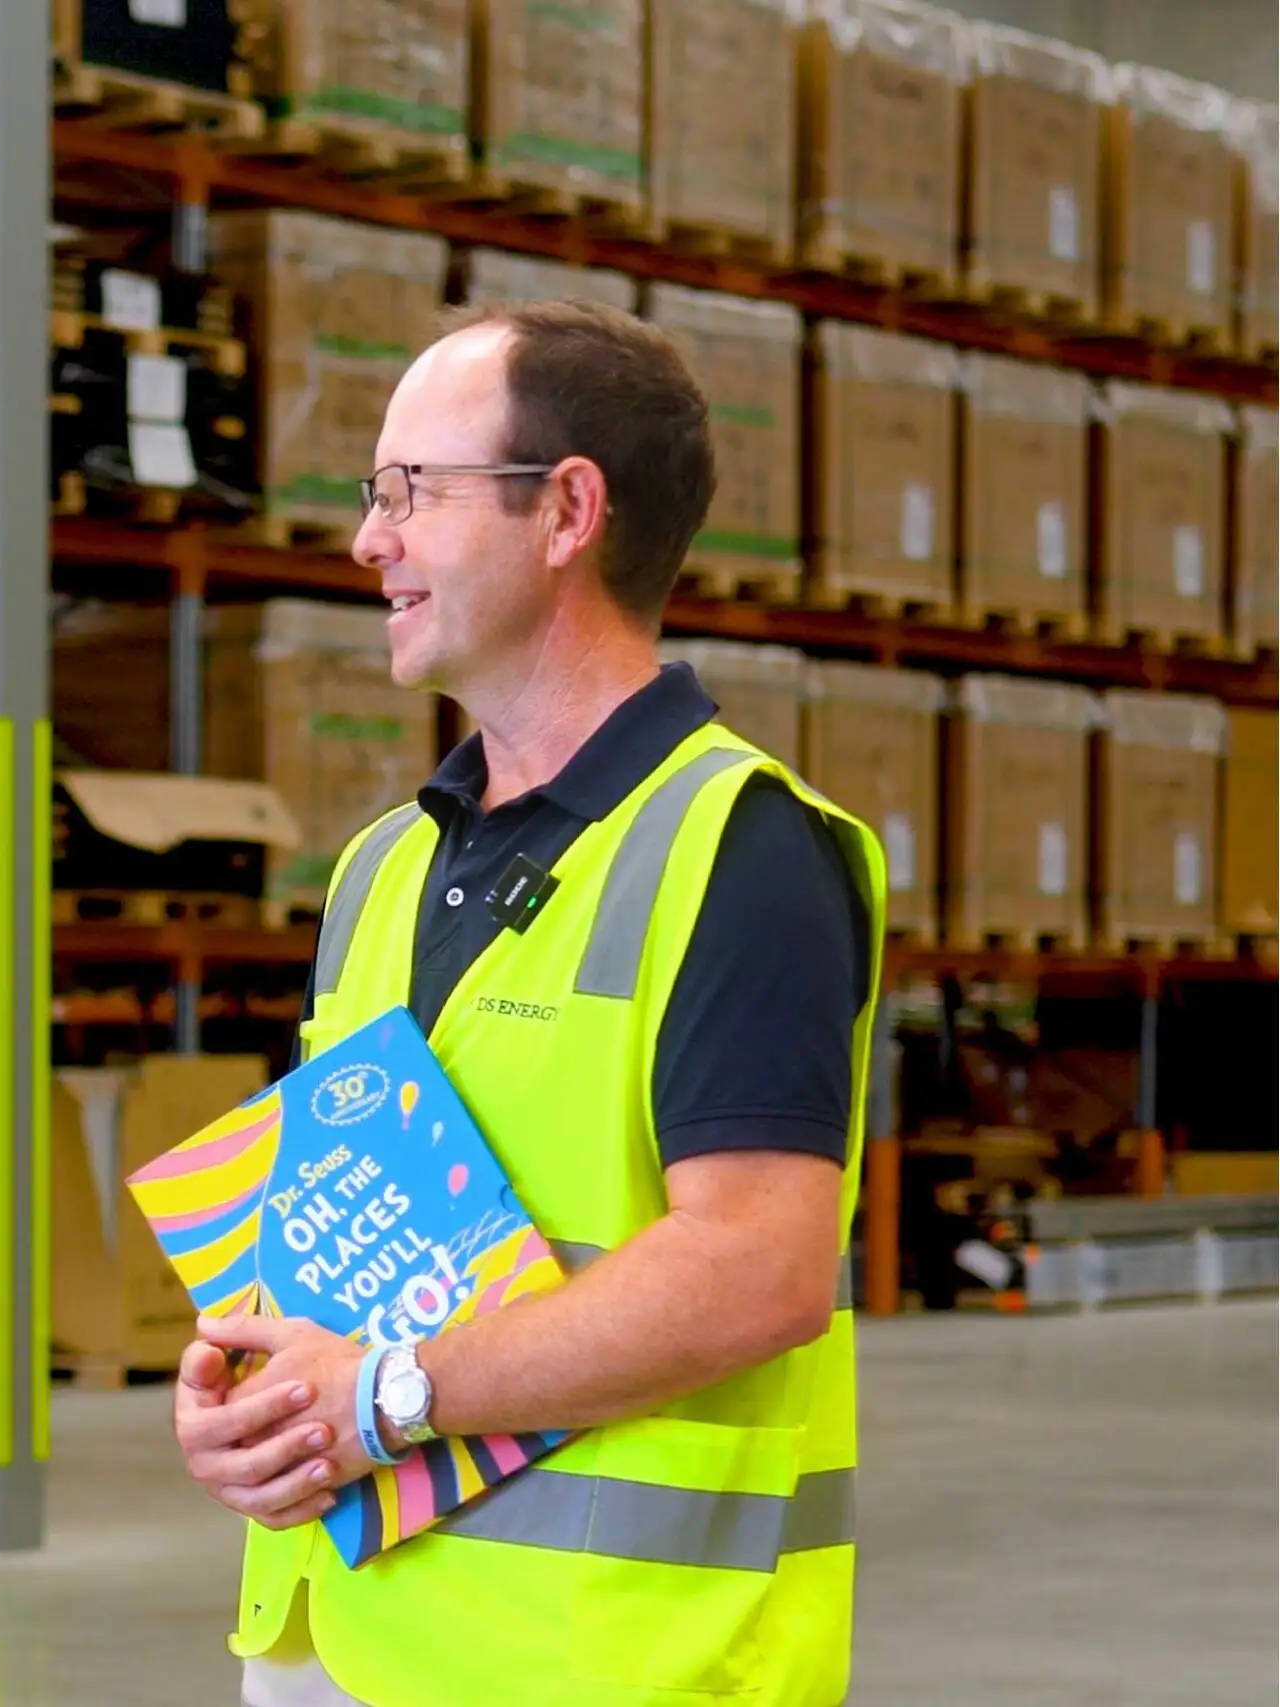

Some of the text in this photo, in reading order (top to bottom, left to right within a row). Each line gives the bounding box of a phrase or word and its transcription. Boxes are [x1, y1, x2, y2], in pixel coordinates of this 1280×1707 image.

[476, 997, 495, 1012] DS
[268, 1144, 352, 1219] Dr. Seuss
[333, 1154, 382, 1200] THE
[294, 1183, 409, 1294] PLACES
[332, 1227, 432, 1313] YOU'LL
[367, 1244, 470, 1347] GO!
